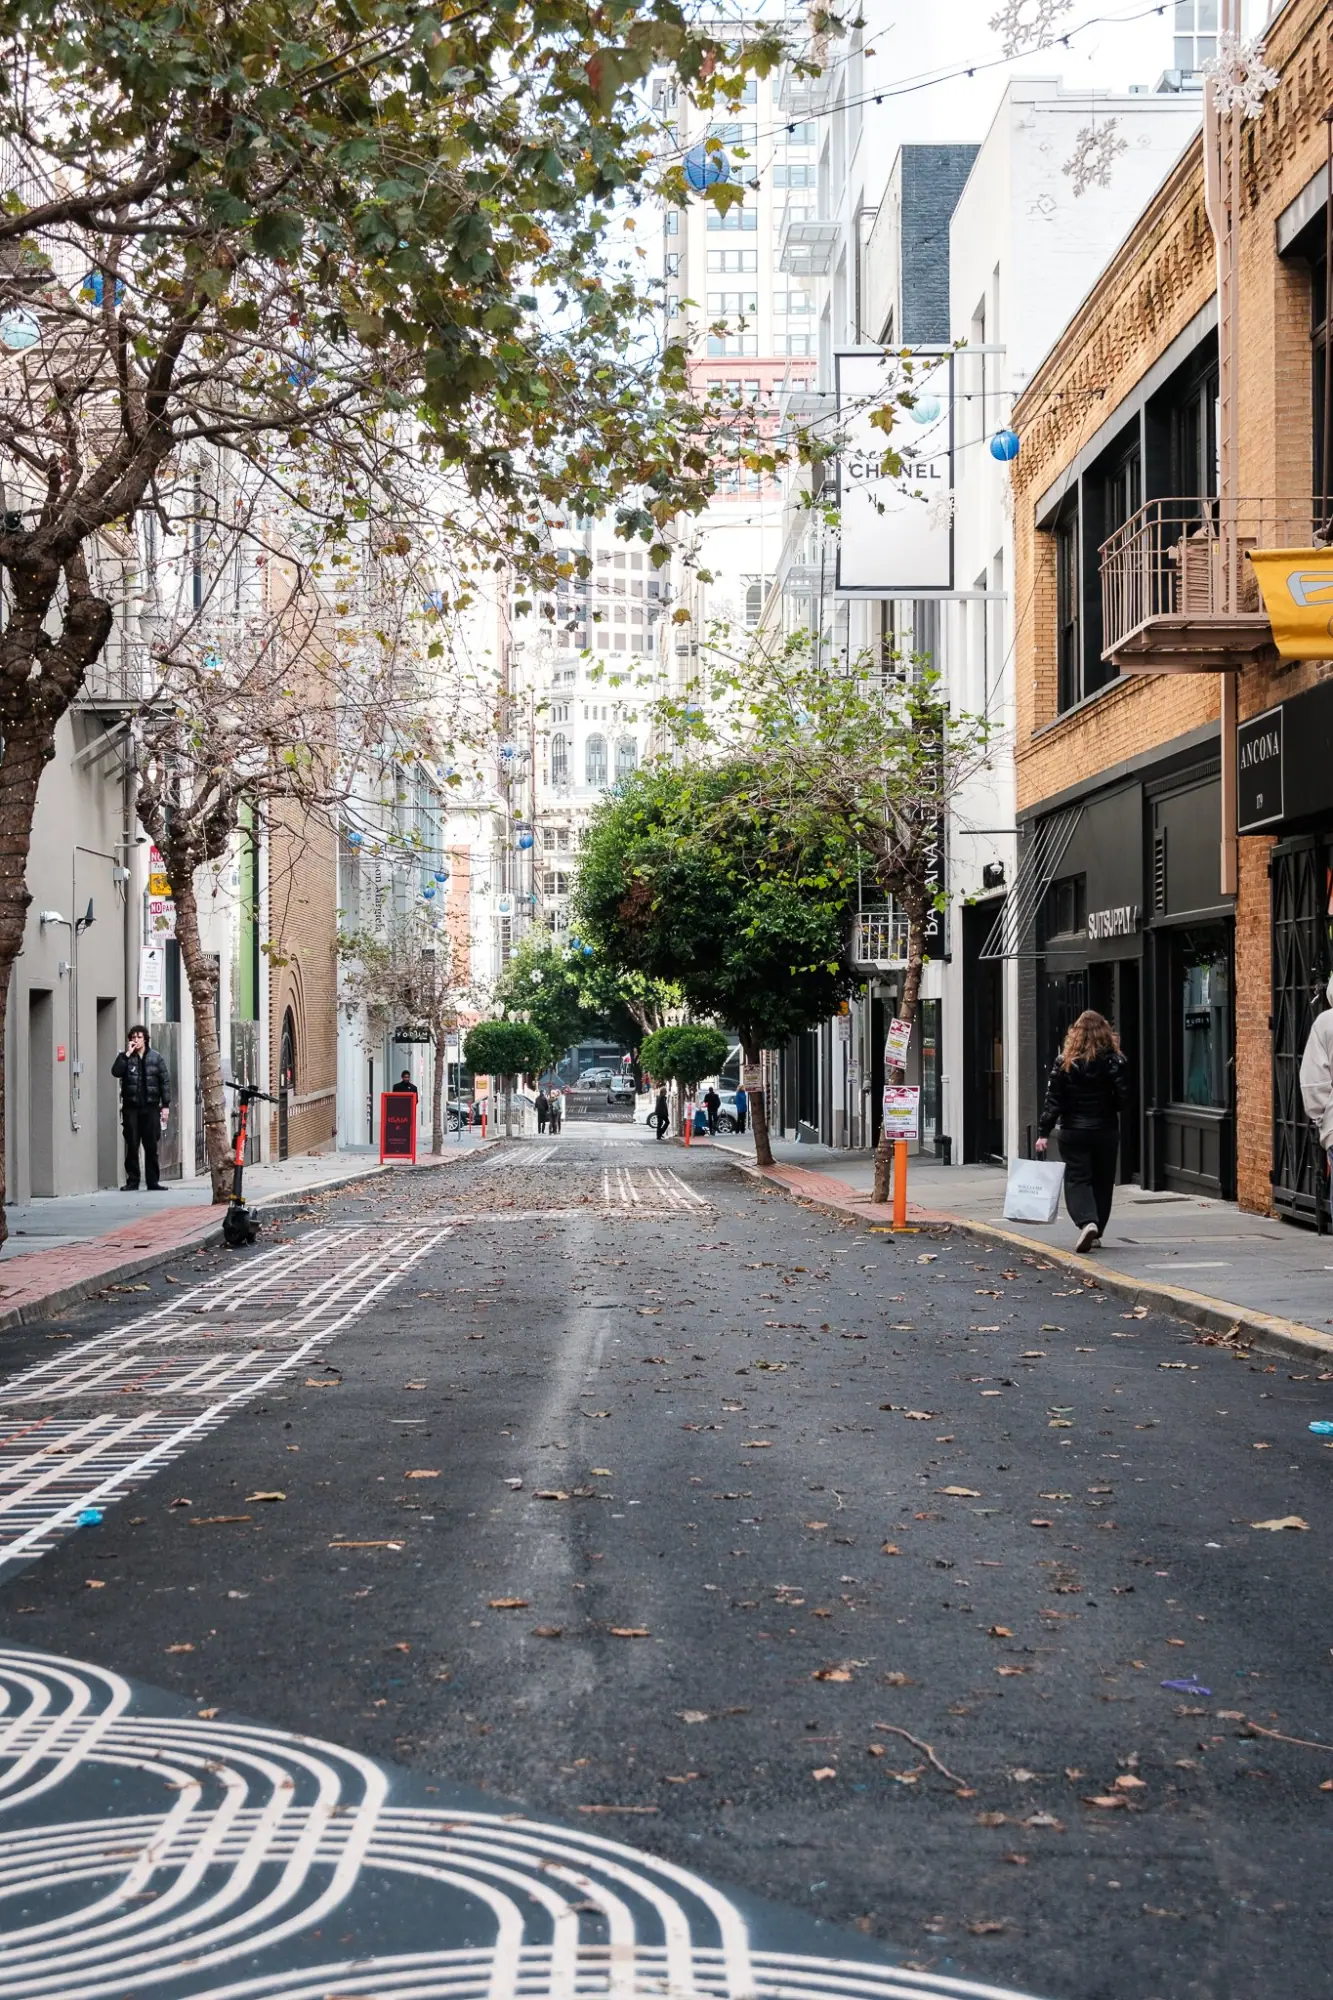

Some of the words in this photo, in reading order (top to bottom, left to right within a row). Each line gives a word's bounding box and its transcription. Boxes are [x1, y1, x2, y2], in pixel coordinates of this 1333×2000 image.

[849, 463, 941, 479] CHNEL
[1240, 730, 1280, 770] ANCONA
[921, 842, 939, 936] BAANA
[151, 902, 161, 912] NO
[1088, 905, 1137, 940] SUITSUPPLY
